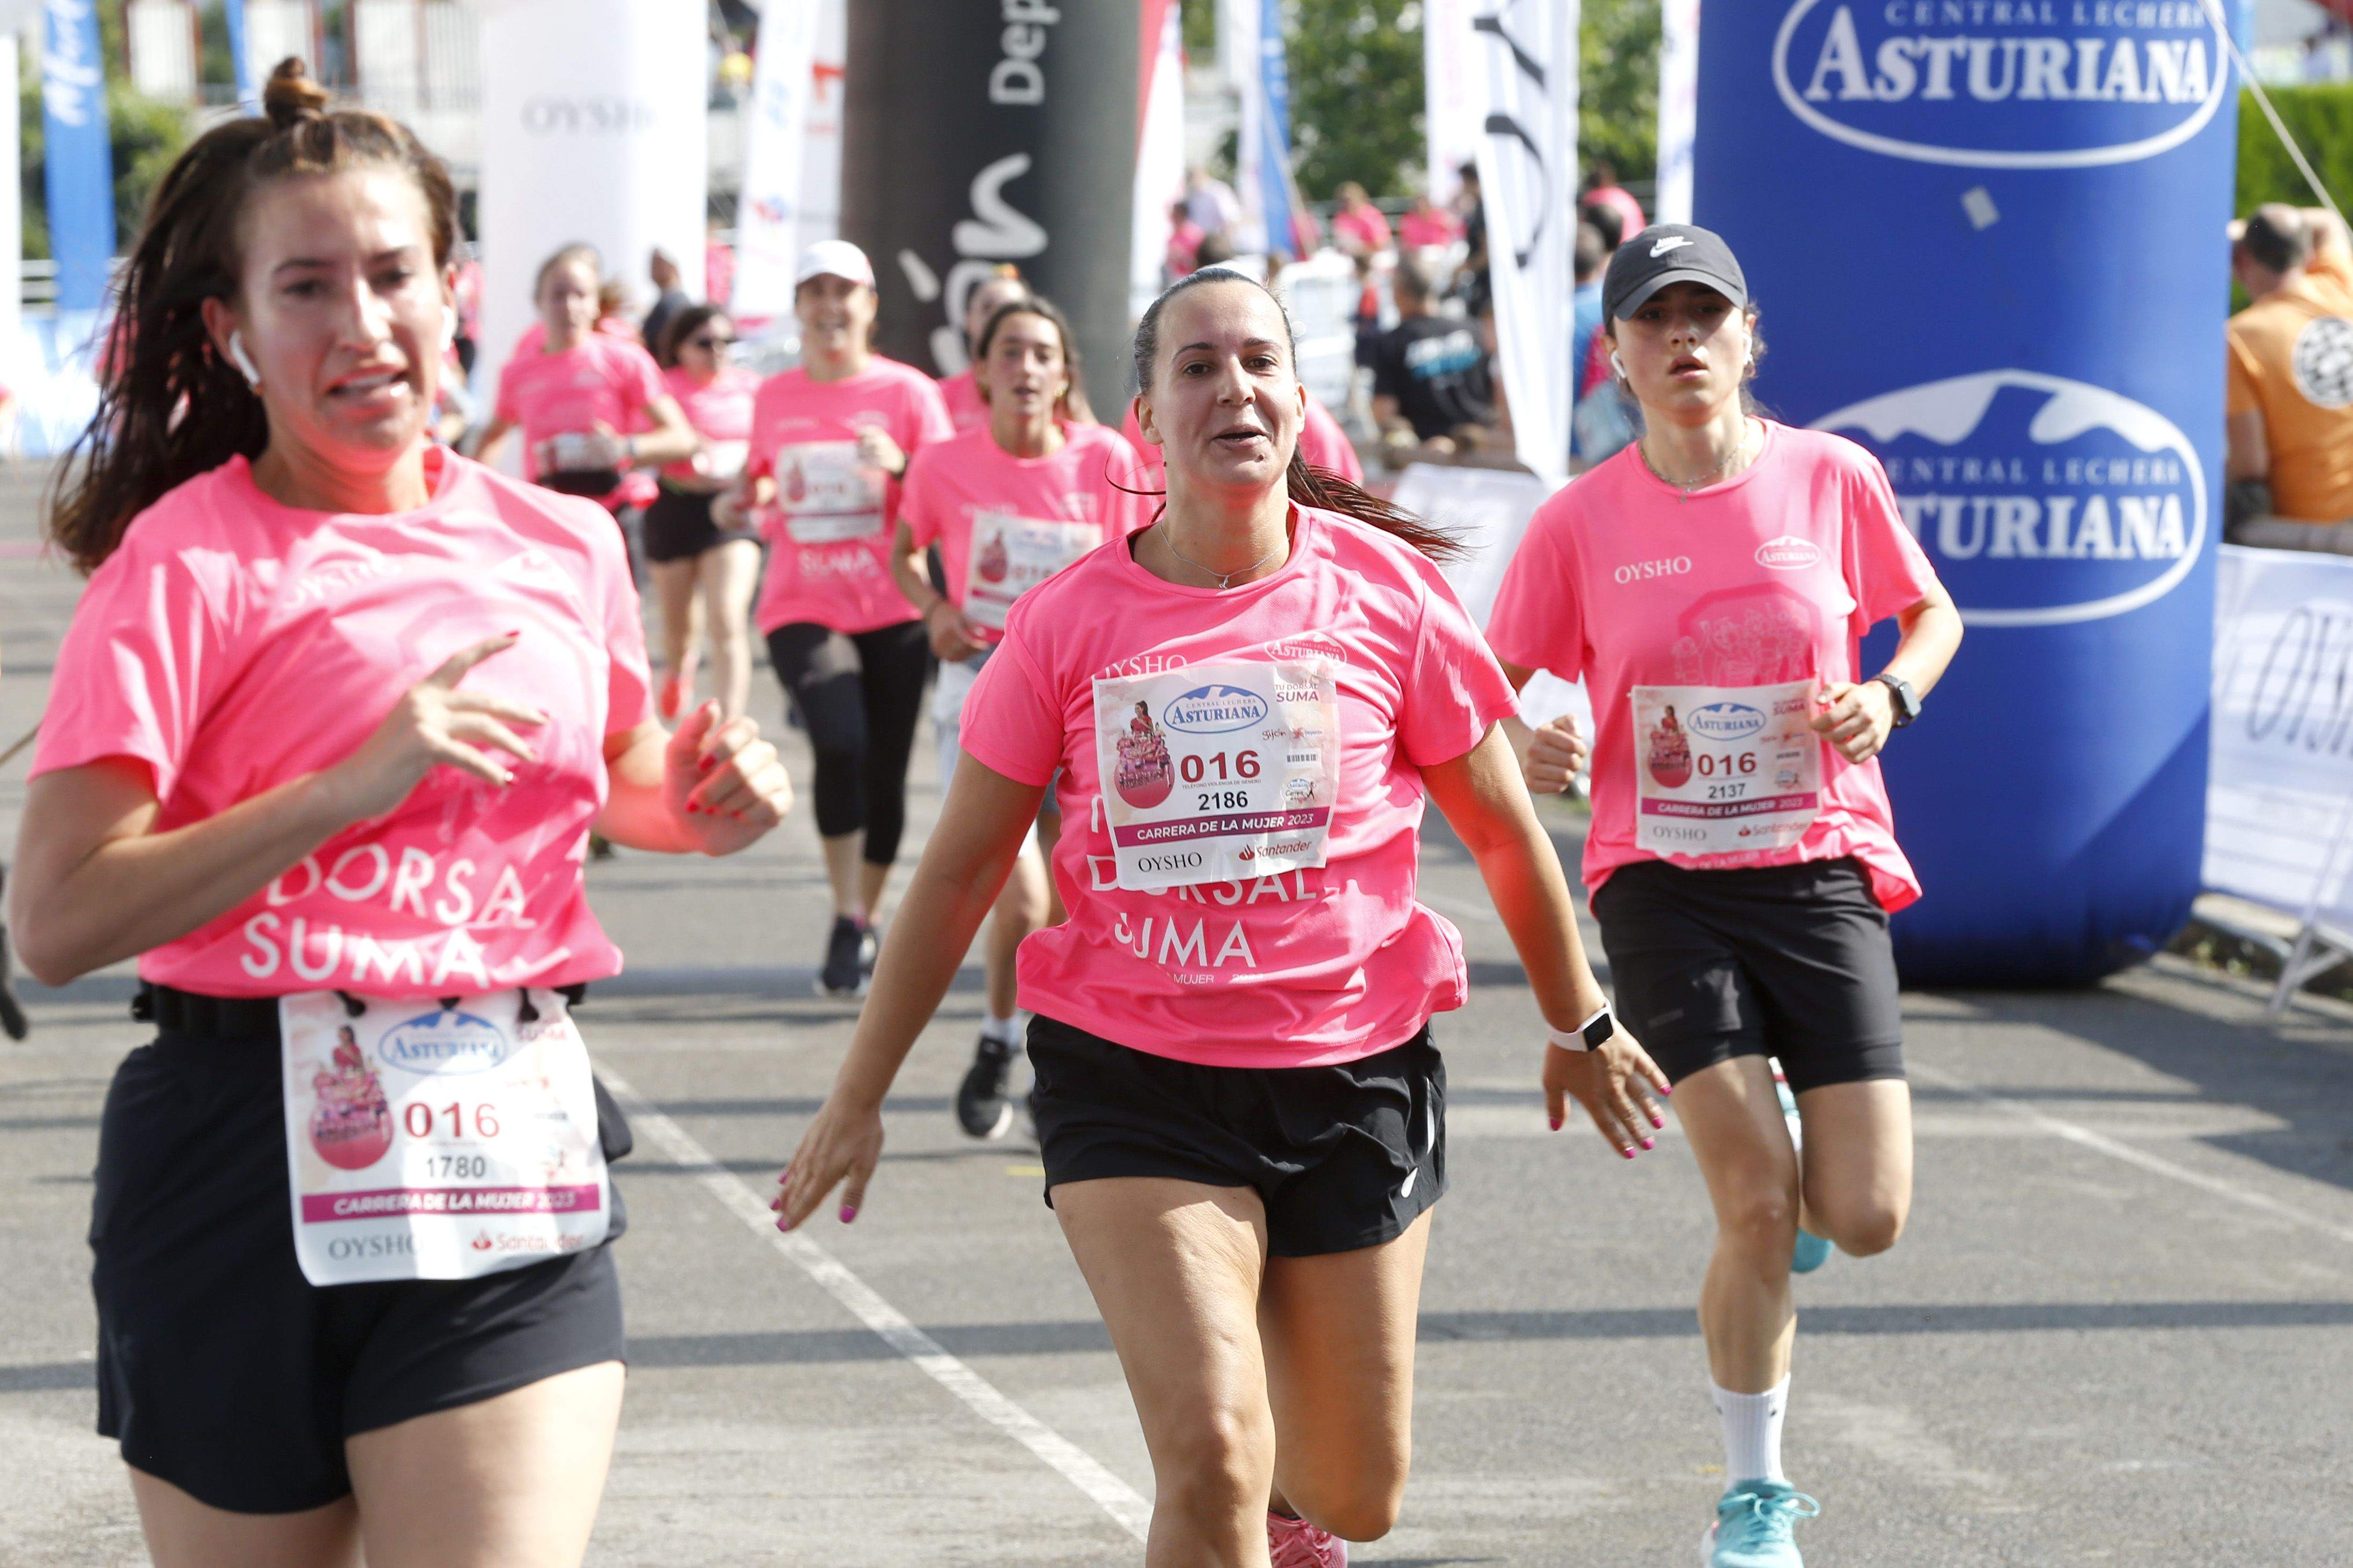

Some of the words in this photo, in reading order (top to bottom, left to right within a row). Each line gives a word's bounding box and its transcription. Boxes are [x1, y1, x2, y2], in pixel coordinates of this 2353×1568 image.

[1884, 0, 2058, 26] CENTRAL
[2073, 0, 2205, 28] LECHERA
[1803, 4, 2210, 103] ASTURIANA
[1887, 457, 2029, 483] ENTRAL
[2043, 457, 2181, 484] LECHERA
[1897, 492, 2186, 560] TURIANA
[1615, 556, 1692, 584] OYSHO
[1277, 691, 1319, 702] SUMA
[1172, 705, 1260, 725] ASTURIANA
[1695, 714, 1759, 731] ASTURIANA
[1181, 750, 1261, 783] 016
[1698, 752, 1757, 777] 016
[1198, 791, 1248, 811] 2186
[1708, 783, 1745, 799] 2137
[1658, 803, 1705, 815] CARRERA
[1707, 804, 1722, 815] DE
[1724, 804, 1738, 815] LA
[1137, 824, 1196, 841] CARRERA
[1200, 821, 1218, 833] DE
[1221, 819, 1239, 831] LA
[1242, 816, 1285, 829] MUJER
[1288, 813, 1314, 826] 2023
[1653, 825, 1707, 842] OYSHO
[1256, 841, 1312, 858] Santander
[1138, 852, 1203, 873] OYSHO
[267, 844, 535, 928] DORSA
[240, 911, 490, 990] SUMA
[1173, 974, 1215, 984] MUJER
[405, 1102, 500, 1138] 016
[427, 1155, 486, 1178] 1780
[498, 1233, 584, 1253] Santader
